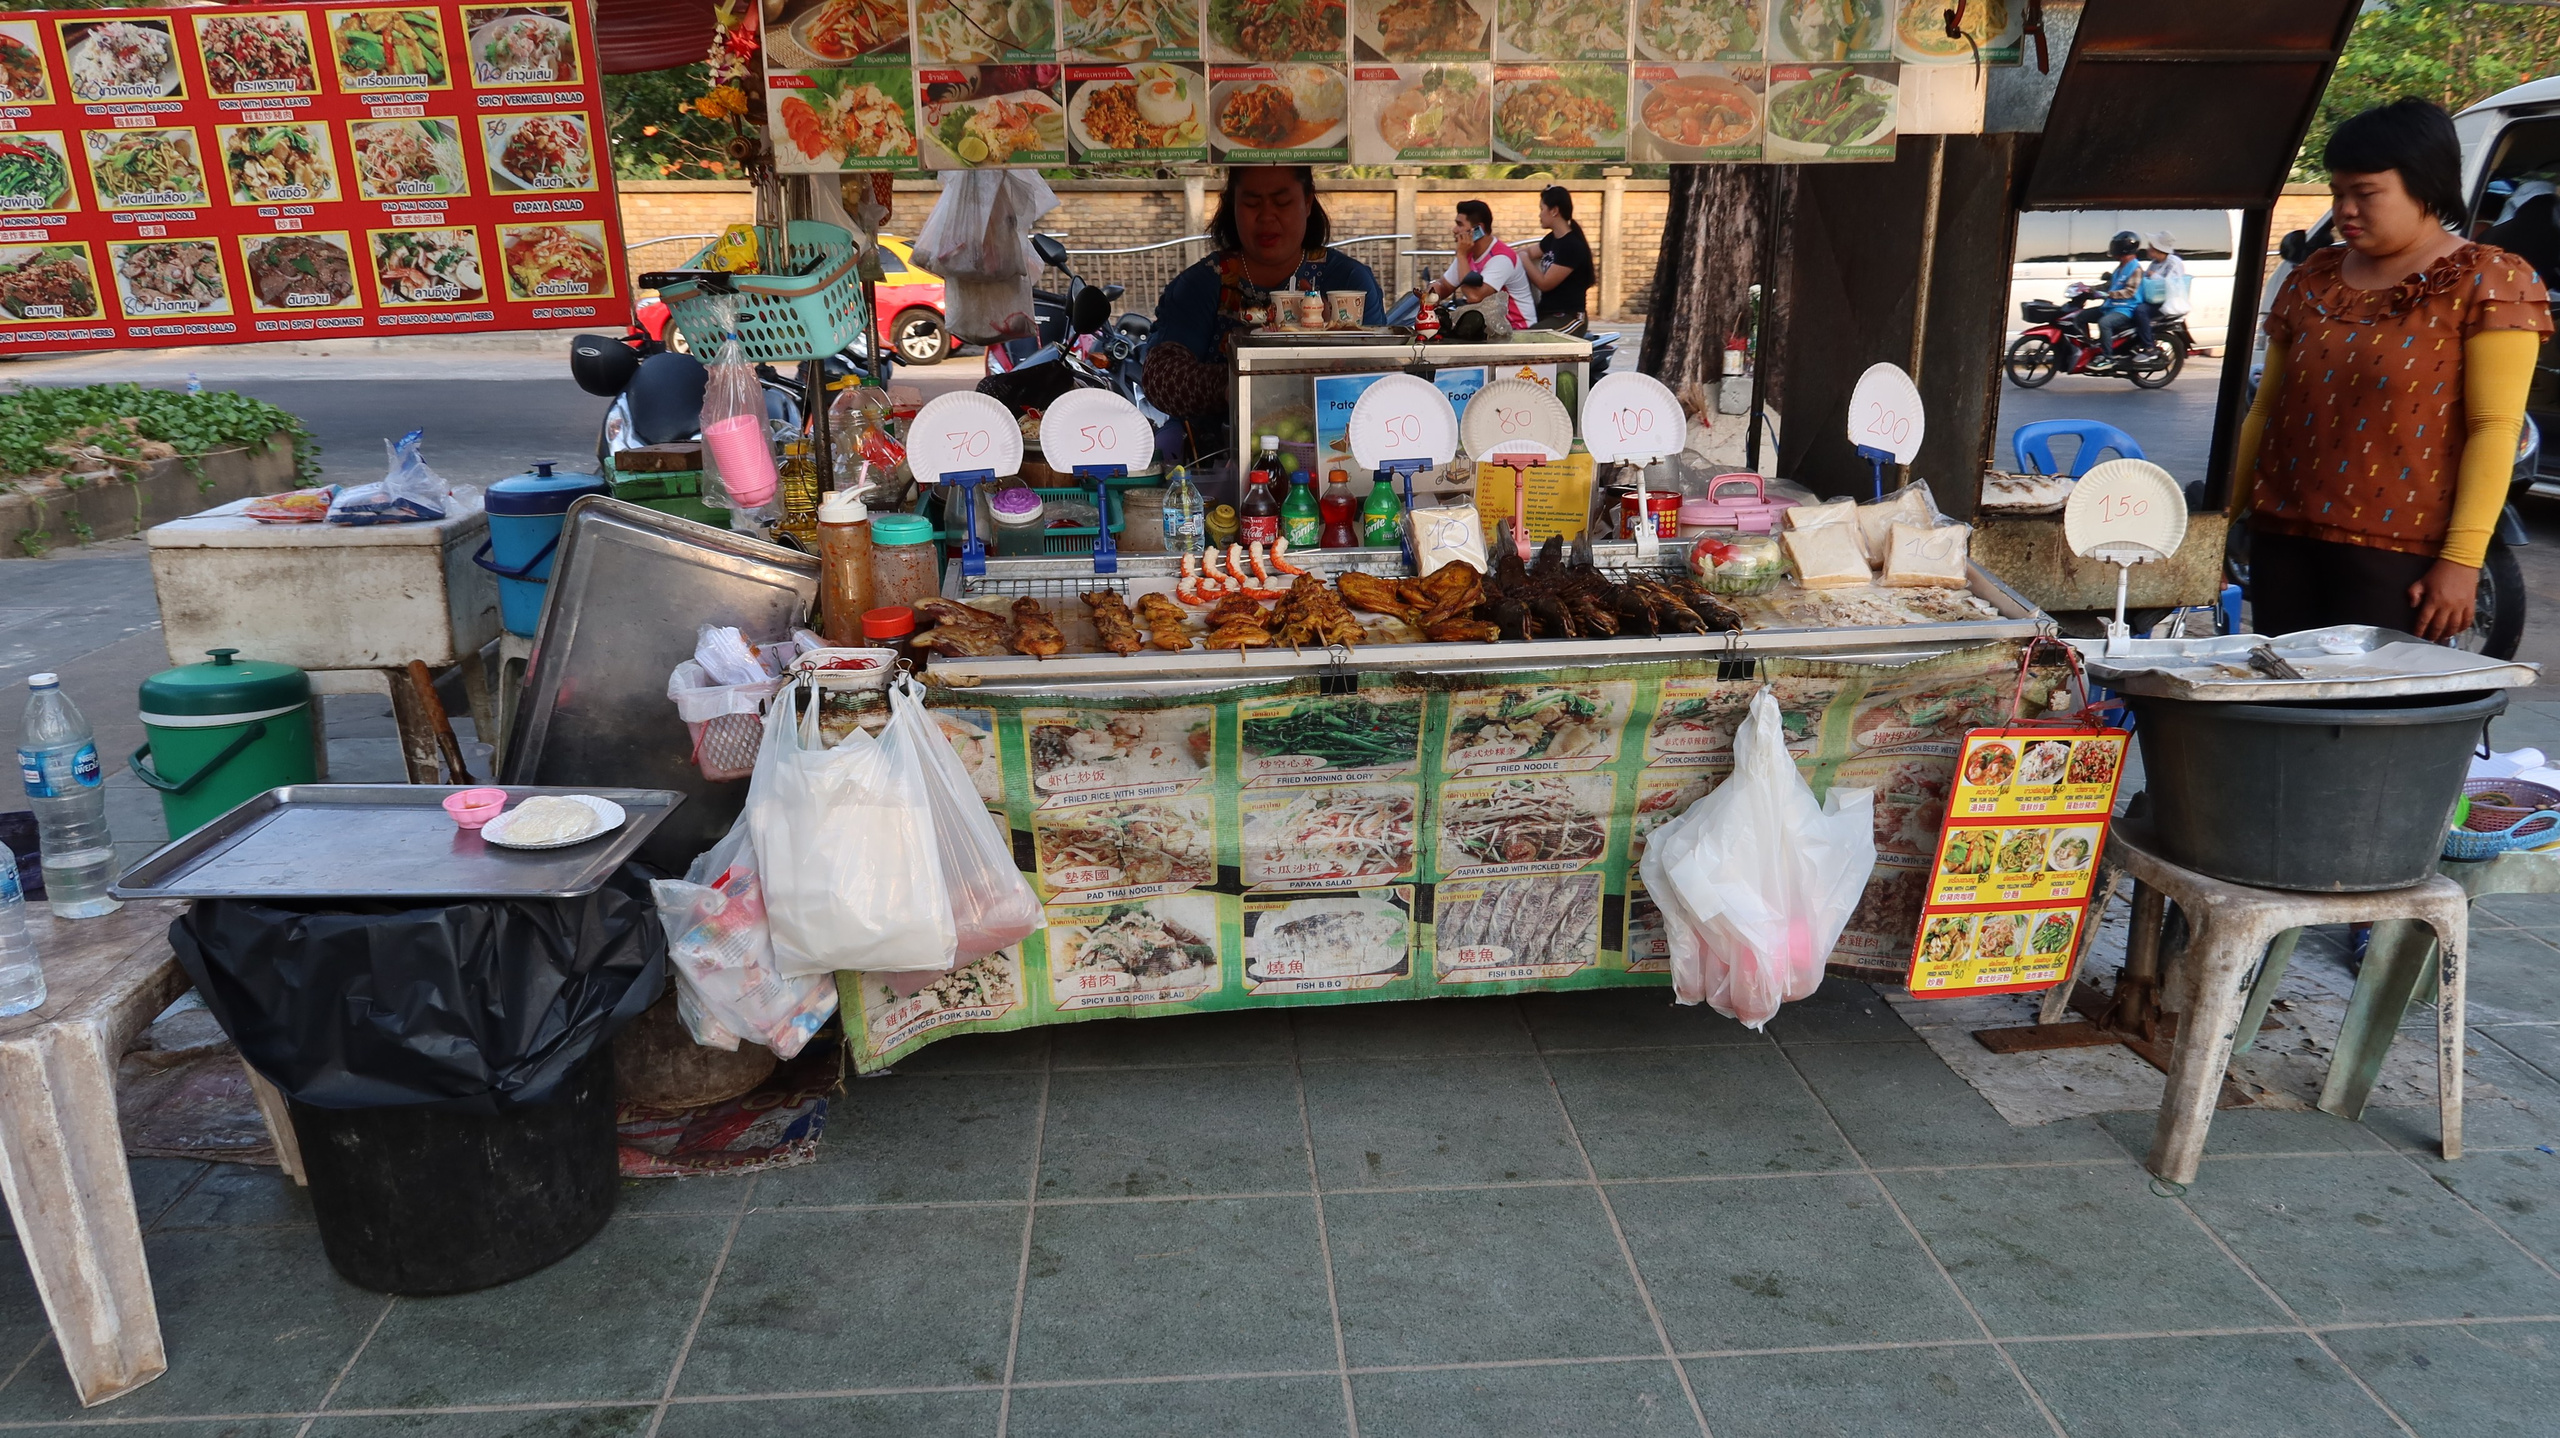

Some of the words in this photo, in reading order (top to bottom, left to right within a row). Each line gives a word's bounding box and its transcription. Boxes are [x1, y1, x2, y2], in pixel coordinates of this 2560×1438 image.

[864, 56, 888, 64] Papaya
[889, 55, 907, 63] salad
[220, 101, 240, 109] PORK
[242, 100, 261, 108] WITH
[264, 99, 283, 107] BASIL
[286, 98, 311, 107] LEAVES
[362, 95, 382, 103] PORK
[385, 94, 403, 102] WITH
[405, 93, 429, 102] CURRY
[478, 96, 502, 106] SPICY
[506, 94, 551, 105] VERMICELLI
[555, 93, 583, 103] SALAD
[6, 108, 30, 116] GUNG
[87, 106, 106, 114] FRIED
[109, 105, 124, 113] RICE
[127, 104, 145, 112] WITH
[148, 104, 181, 112] SEAFOOD
[1030, 153, 1047, 161] Fried
[1090, 150, 1106, 158] Fried
[1168, 149, 1189, 157] served
[1190, 149, 1202, 157] rice
[1231, 149, 1248, 158] Fried
[1249, 150, 1260, 158] red
[1261, 151, 1277, 159] curry
[1278, 149, 1293, 157] with
[1293, 149, 1308, 159] pork
[1308, 149, 1329, 157] served
[1330, 149, 1343, 157] rice
[1403, 149, 1429, 158] Coconut
[1461, 148, 1485, 157] chicken
[1537, 149, 1554, 157] Fried
[1833, 147, 1848, 155] Fried
[850, 158, 866, 167] Glass
[868, 158, 895, 166] noodles
[896, 157, 913, 166] salad
[534, 175, 563, 188] ส้มตำ
[258, 208, 278, 216] FRIED
[284, 206, 314, 215] NOODLE
[383, 202, 398, 211] PAD
[400, 202, 417, 210] THAI
[419, 200, 448, 209] NOODLE
[515, 202, 550, 212] PAPAYA
[553, 201, 583, 211] SALAD
[5, 217, 39, 225] MORNING
[43, 216, 67, 224] GLORY
[114, 214, 133, 222] FRIED
[135, 213, 162, 221] YELLOW
[166, 211, 196, 220] NOODLE
[287, 294, 329, 306] ตับหวาน
[25, 306, 63, 319] ลาบหมู
[378, 316, 397, 325] SPICY
[399, 314, 429, 324] SEAFOOD
[431, 313, 452, 323] SALAD
[454, 312, 470, 321] WITH
[472, 311, 494, 321] HERBS
[533, 309, 551, 318] SPICY
[553, 308, 572, 317] CORN
[573, 306, 595, 315] SALAD
[129, 327, 150, 336] SLIDE
[153, 326, 184, 335] GRILLED
[186, 325, 208, 333] PORK
[210, 323, 236, 332] SALAD
[256, 321, 277, 331] LIVER
[280, 321, 289, 330] IN
[292, 319, 314, 329] SPICY
[317, 317, 363, 327] CONDIMENT
[18, 332, 45, 341] MINCED
[48, 331, 68, 340] PORK
[70, 330, 89, 339] WITH
[91, 329, 114, 338] HERBS
[1499, 408, 1532, 435] 80
[1612, 407, 1654, 443] 100
[1867, 402, 1910, 445] 200
[1384, 415, 1421, 448] 50
[1080, 425, 1117, 453] 50
[946, 430, 990, 462] 70
[2098, 494, 2149, 523] 150
[1290, 518, 1316, 542] Sprite
[1364, 518, 1386, 538] Sprite
[1426, 519, 1469, 550] 10
[1904, 537, 1953, 561] 10
[1940, 746, 1958, 755] WITH
[1258, 757, 1315, 770] 炒空心菜
[1495, 764, 1521, 772] FRIED
[1523, 762, 1559, 771] NOODLE
[1048, 768, 1106, 787] 虾仁炒饭
[1277, 775, 1301, 785] FRIED
[1303, 774, 1344, 784] MORNING
[1346, 773, 1374, 782] GLORY
[1063, 794, 1088, 805] FRIED
[1090, 792, 1111, 802] RICE
[1113, 790, 1135, 800] WITH
[1138, 785, 1176, 797] SHRIMPS
[1876, 854, 1900, 863] SALAD
[1902, 855, 1920, 864] WITH
[1263, 862, 1321, 875] 木瓜沙拉
[1457, 868, 1485, 876] PAPAYA
[1487, 866, 1508, 875] SALAD
[1511, 865, 1529, 873] WITH
[1530, 863, 1560, 872] PICKLED
[1562, 861, 1578, 870] FISH
[1289, 880, 1323, 889] PAPAYA
[1325, 878, 1352, 888] SALAD
[1086, 891, 1104, 901] PAD
[1108, 889, 1126, 899] THAI
[1129, 885, 1163, 896] NOODLE
[1458, 947, 1495, 963] 燒魚
[1266, 959, 1304, 976] 燒魚
[1488, 970, 1507, 979] FISH
[1510, 968, 1533, 977] B.B.Q
[1079, 974, 1116, 989] 豬肉
[1296, 981, 1316, 990] FISH
[1319, 980, 1342, 989] B.B.Q
[1081, 996, 1105, 1006] SPICY
[1133, 993, 1156, 1002] PORK
[887, 1030, 907, 1048] SPICY
[907, 1017, 937, 1036] MINCED
[939, 1011, 962, 1024] PORK
[964, 1009, 992, 1019] SALAD
